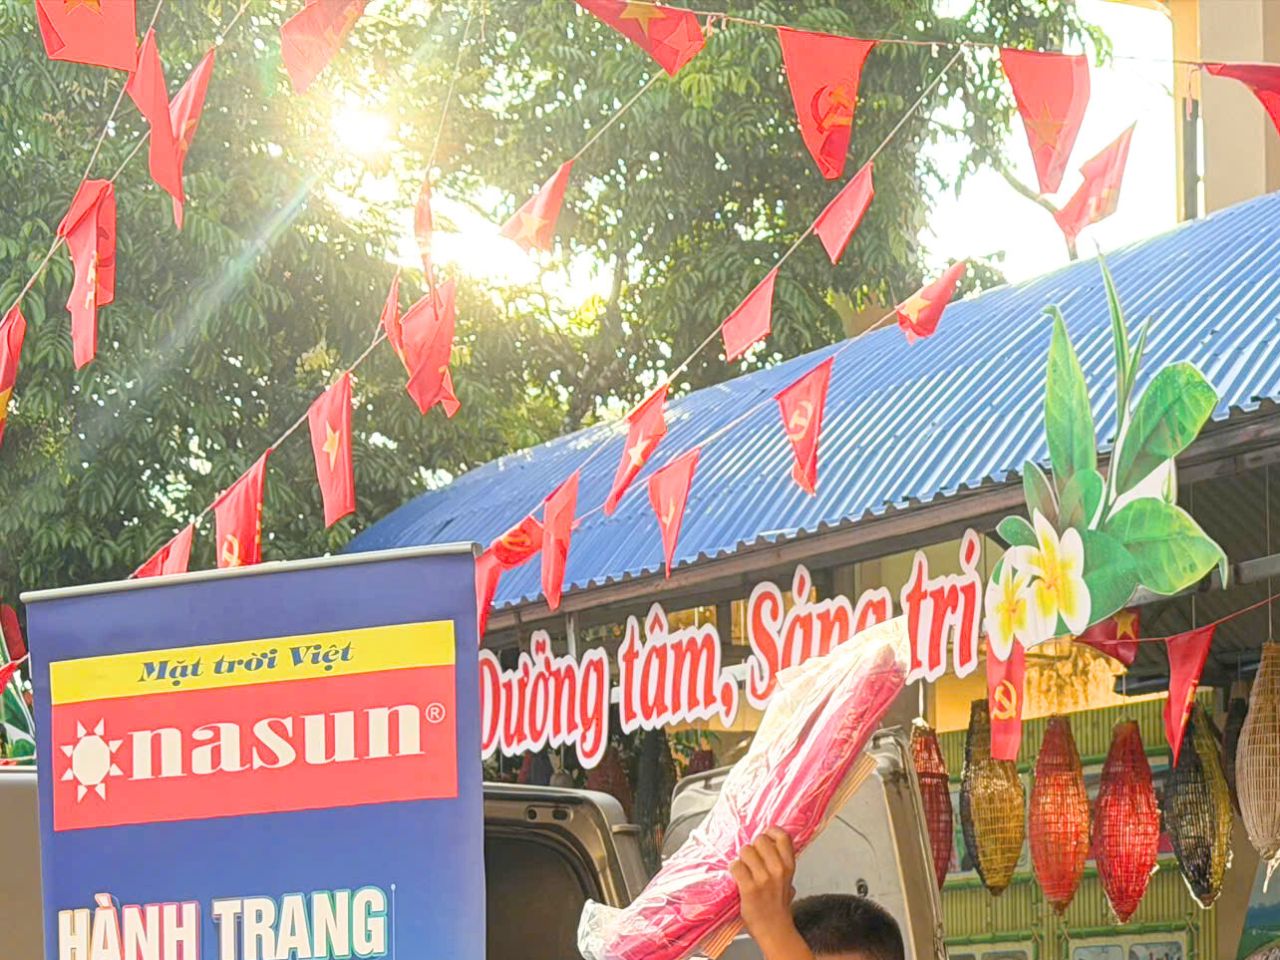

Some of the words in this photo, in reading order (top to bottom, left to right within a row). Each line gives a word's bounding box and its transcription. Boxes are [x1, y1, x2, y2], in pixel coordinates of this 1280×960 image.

[137, 661, 204, 687] Mặt
[213, 648, 278, 675] trời
[289, 641, 356, 671] Việt
[479, 635, 605, 760] Dưỡng
[622, 611, 736, 722] tâm,
[127, 702, 426, 782] nasun
